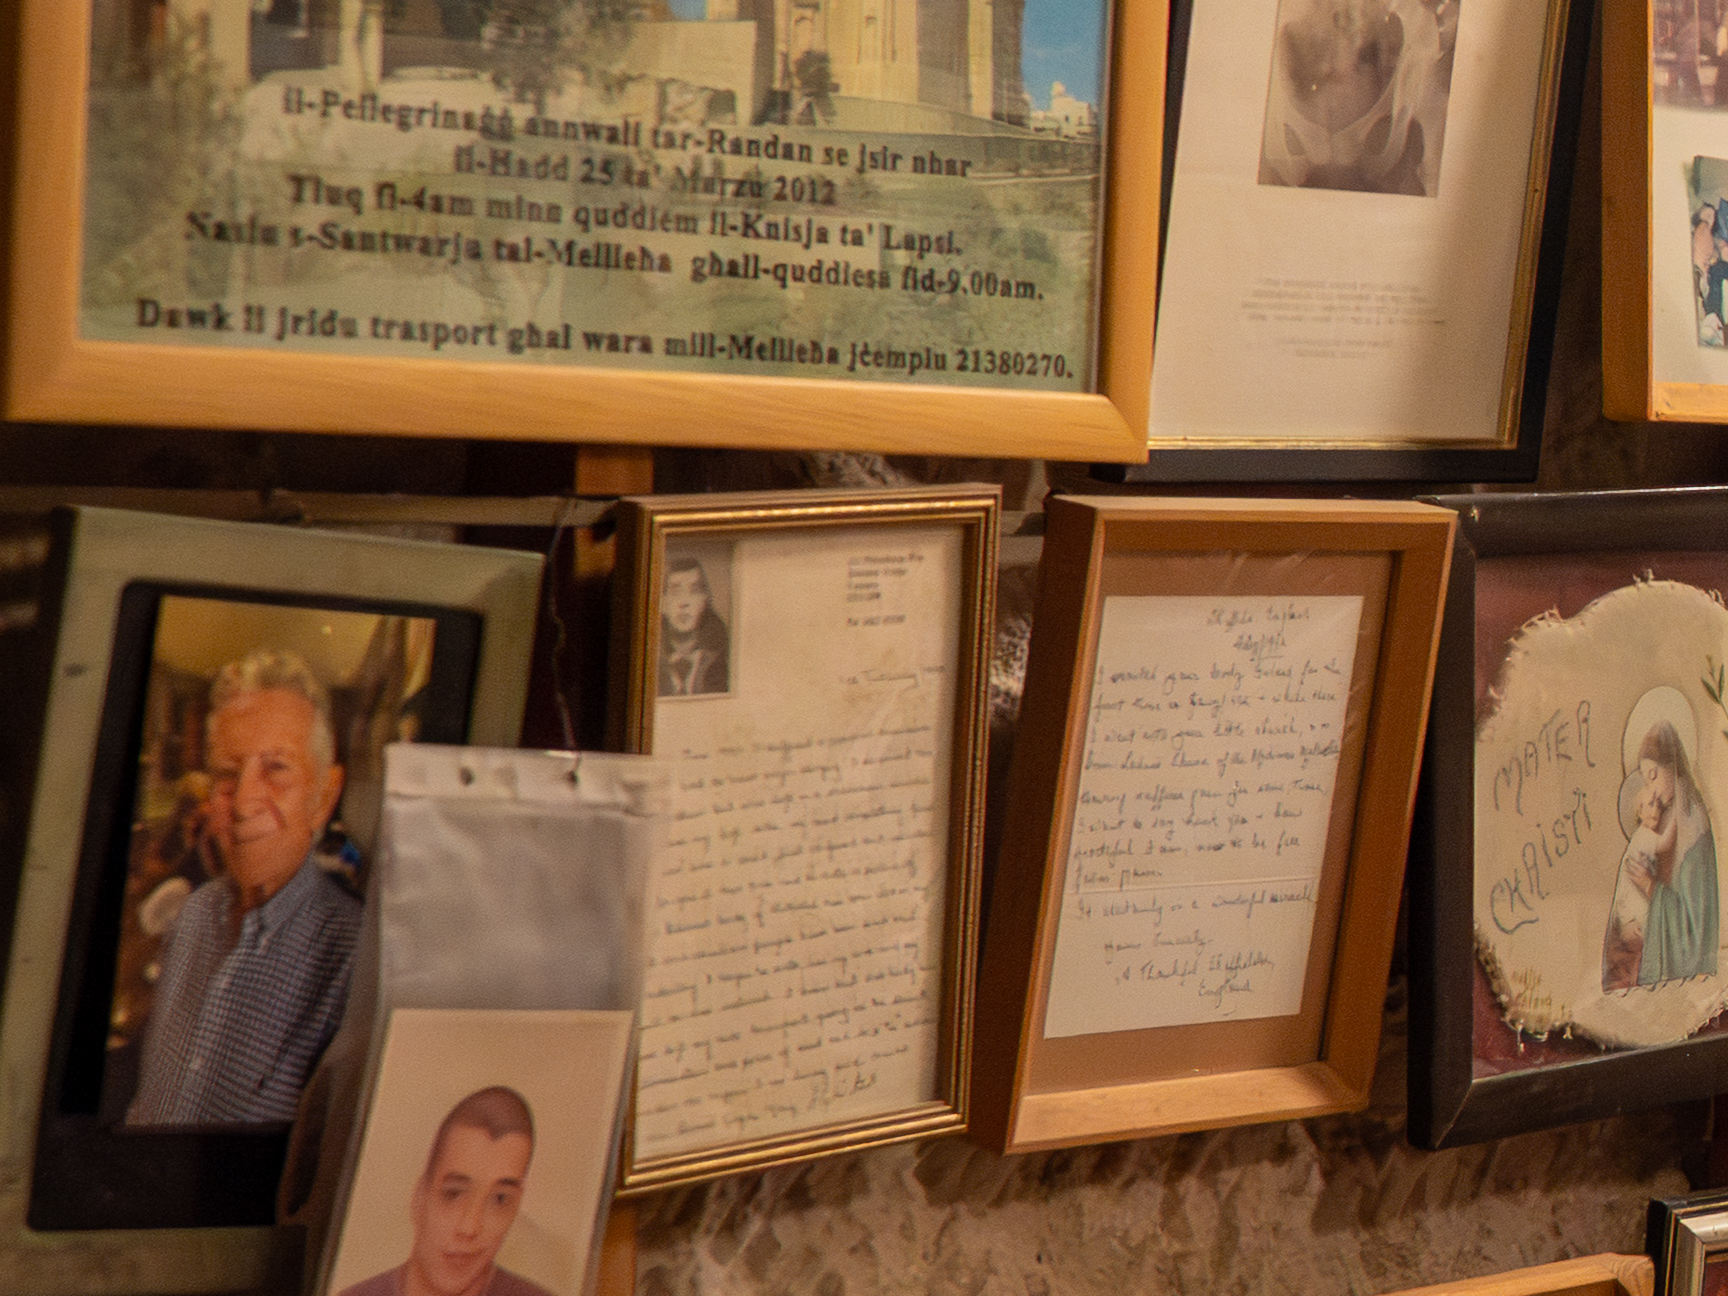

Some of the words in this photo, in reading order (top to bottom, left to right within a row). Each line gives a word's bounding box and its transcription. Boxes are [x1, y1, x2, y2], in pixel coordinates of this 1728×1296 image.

[524, 114, 641, 150] annwali
[650, 125, 812, 165] tar-Randan
[821, 144, 850, 168] se
[855, 142, 904, 176] jsir
[286, 174, 364, 216] Tluq
[485, 193, 562, 224] minn
[839, 220, 875, 249] ta'
[881, 224, 964, 261] Lapsi.
[673, 165, 764, 200] Marzu
[773, 175, 836, 206] 2012
[186, 210, 279, 248] Naslu
[136, 298, 235, 333] Dawk
[274, 307, 358, 342] jridu
[954, 349, 1075, 381] 21380270.
[1494, 699, 1597, 817] MATER
